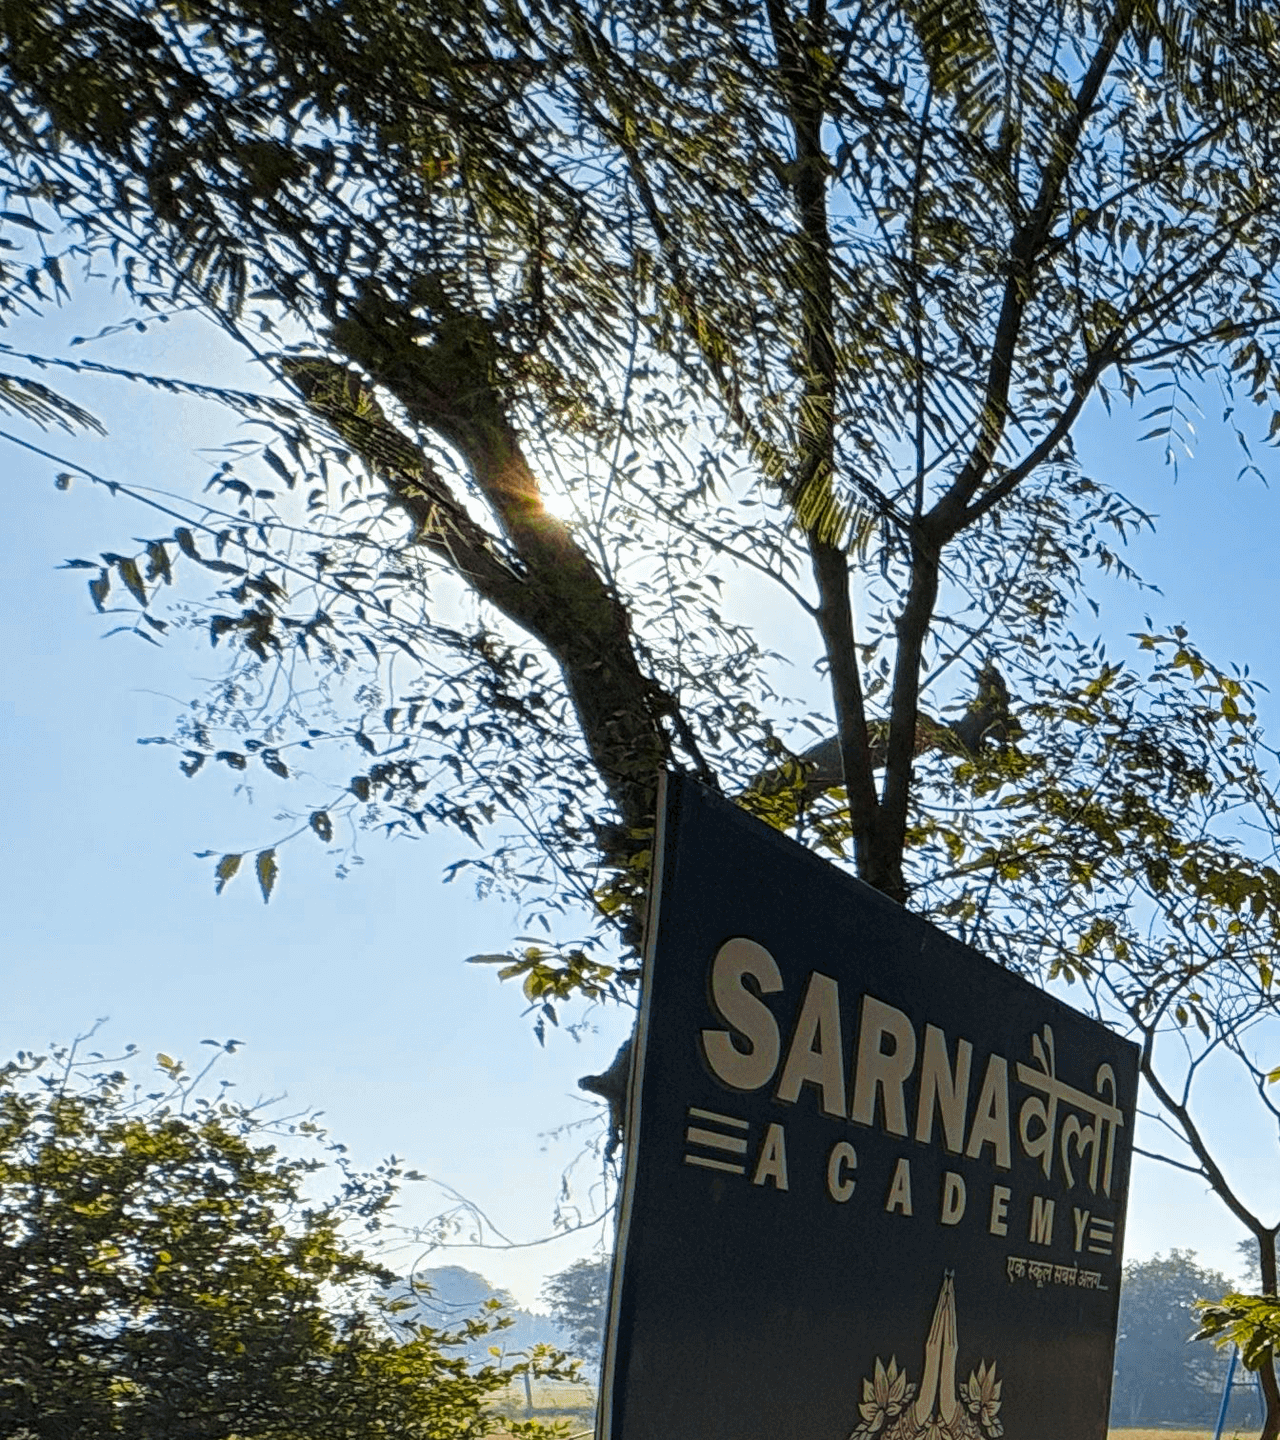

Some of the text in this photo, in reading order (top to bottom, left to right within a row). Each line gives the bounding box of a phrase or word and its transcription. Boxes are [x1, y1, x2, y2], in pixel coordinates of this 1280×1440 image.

[753, 1122, 1090, 1253] ACADEMY
[1007, 1255, 1027, 1283] एक
[1028, 1259, 1054, 1288] स्कूल
[1054, 1260, 1078, 1287] सबसे
